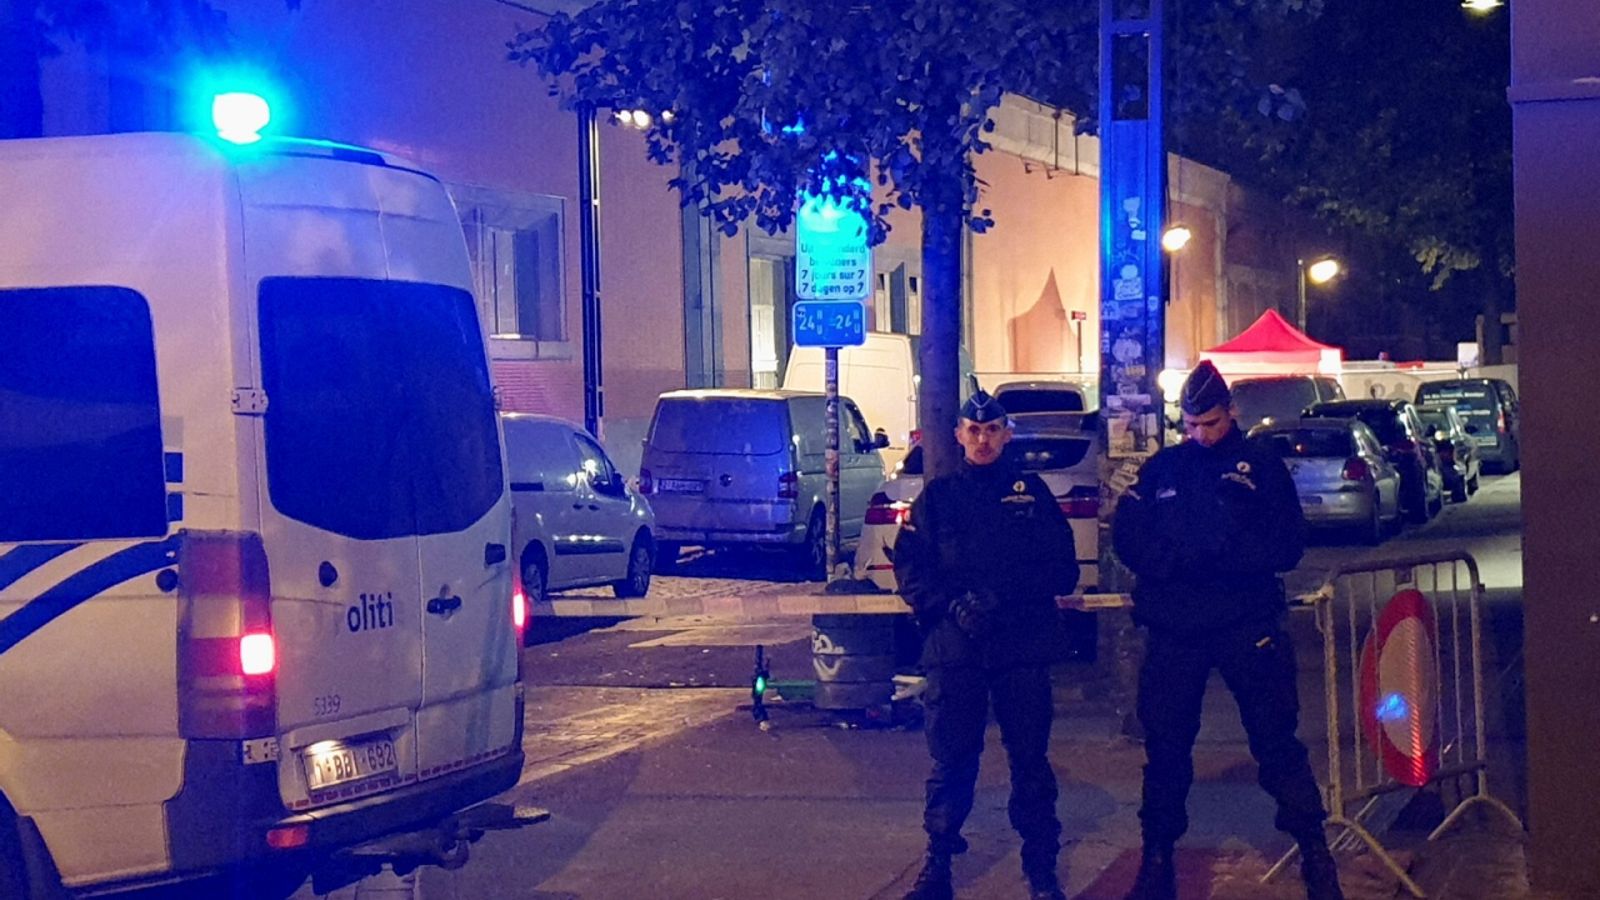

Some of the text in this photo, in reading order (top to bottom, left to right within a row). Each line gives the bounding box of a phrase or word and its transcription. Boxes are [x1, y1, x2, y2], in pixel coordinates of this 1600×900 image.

[801, 269, 809, 280] 7
[839, 271, 855, 280] sur
[857, 269, 865, 280] 7
[801, 282, 809, 293] 7
[843, 285, 855, 296] op
[857, 282, 865, 293] 7
[347, 591, 393, 633] oliti
